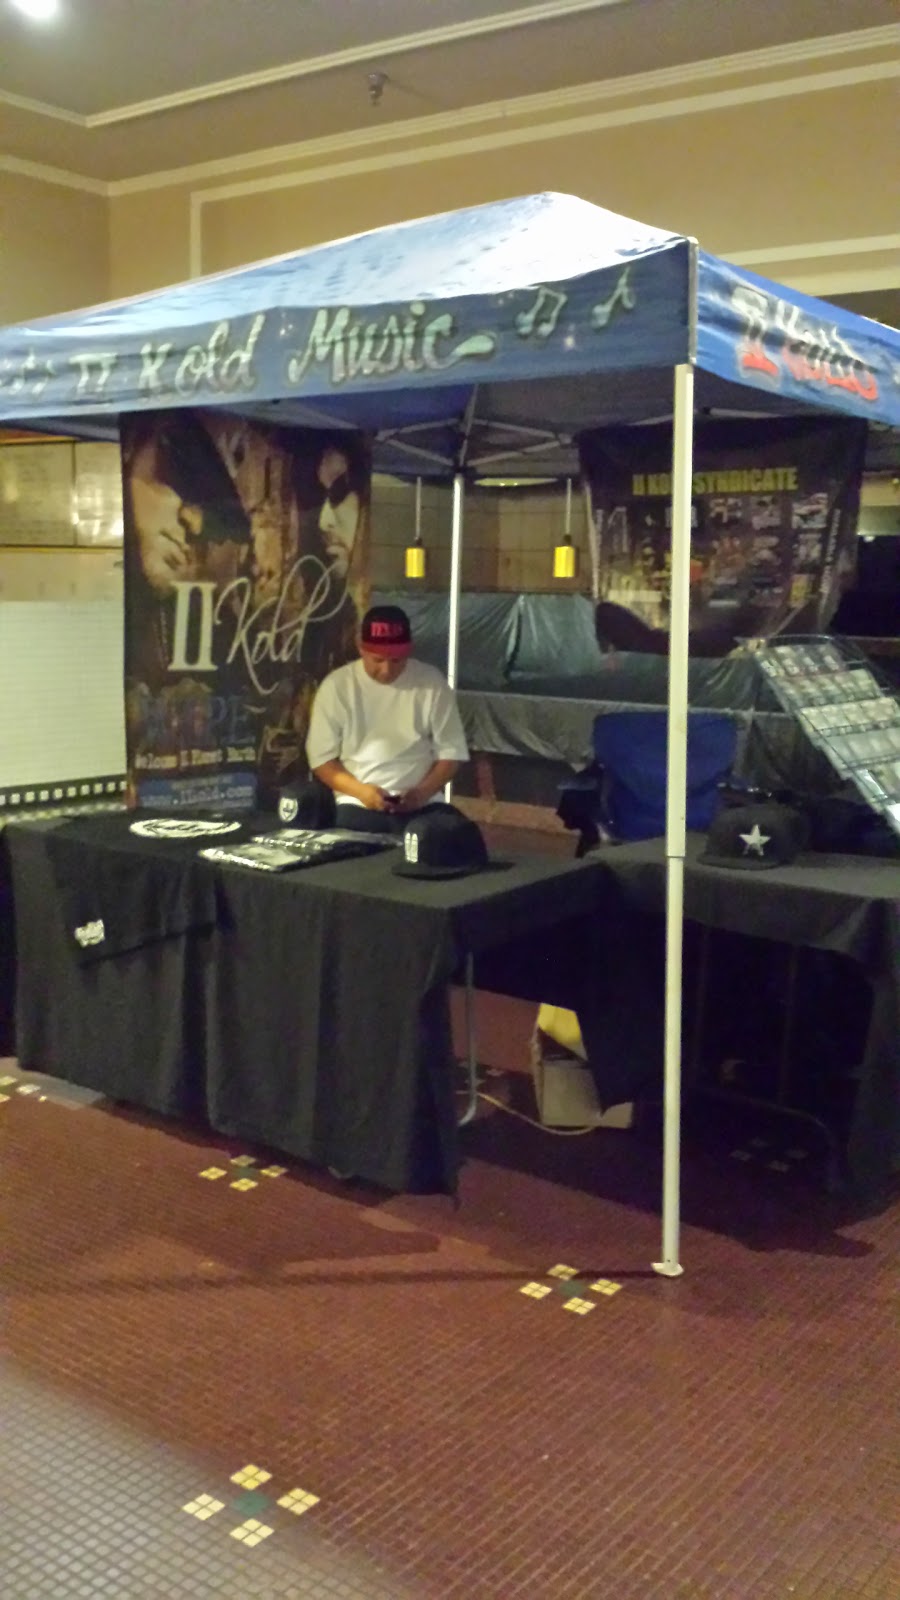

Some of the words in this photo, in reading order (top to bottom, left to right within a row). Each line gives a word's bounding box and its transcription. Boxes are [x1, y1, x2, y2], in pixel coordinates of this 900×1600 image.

[138, 313, 266, 398] Kold
[288, 302, 475, 384] Music
[692, 466, 799, 496] SYNDICATE
[167, 580, 218, 672] II
[214, 554, 348, 695] Kold
